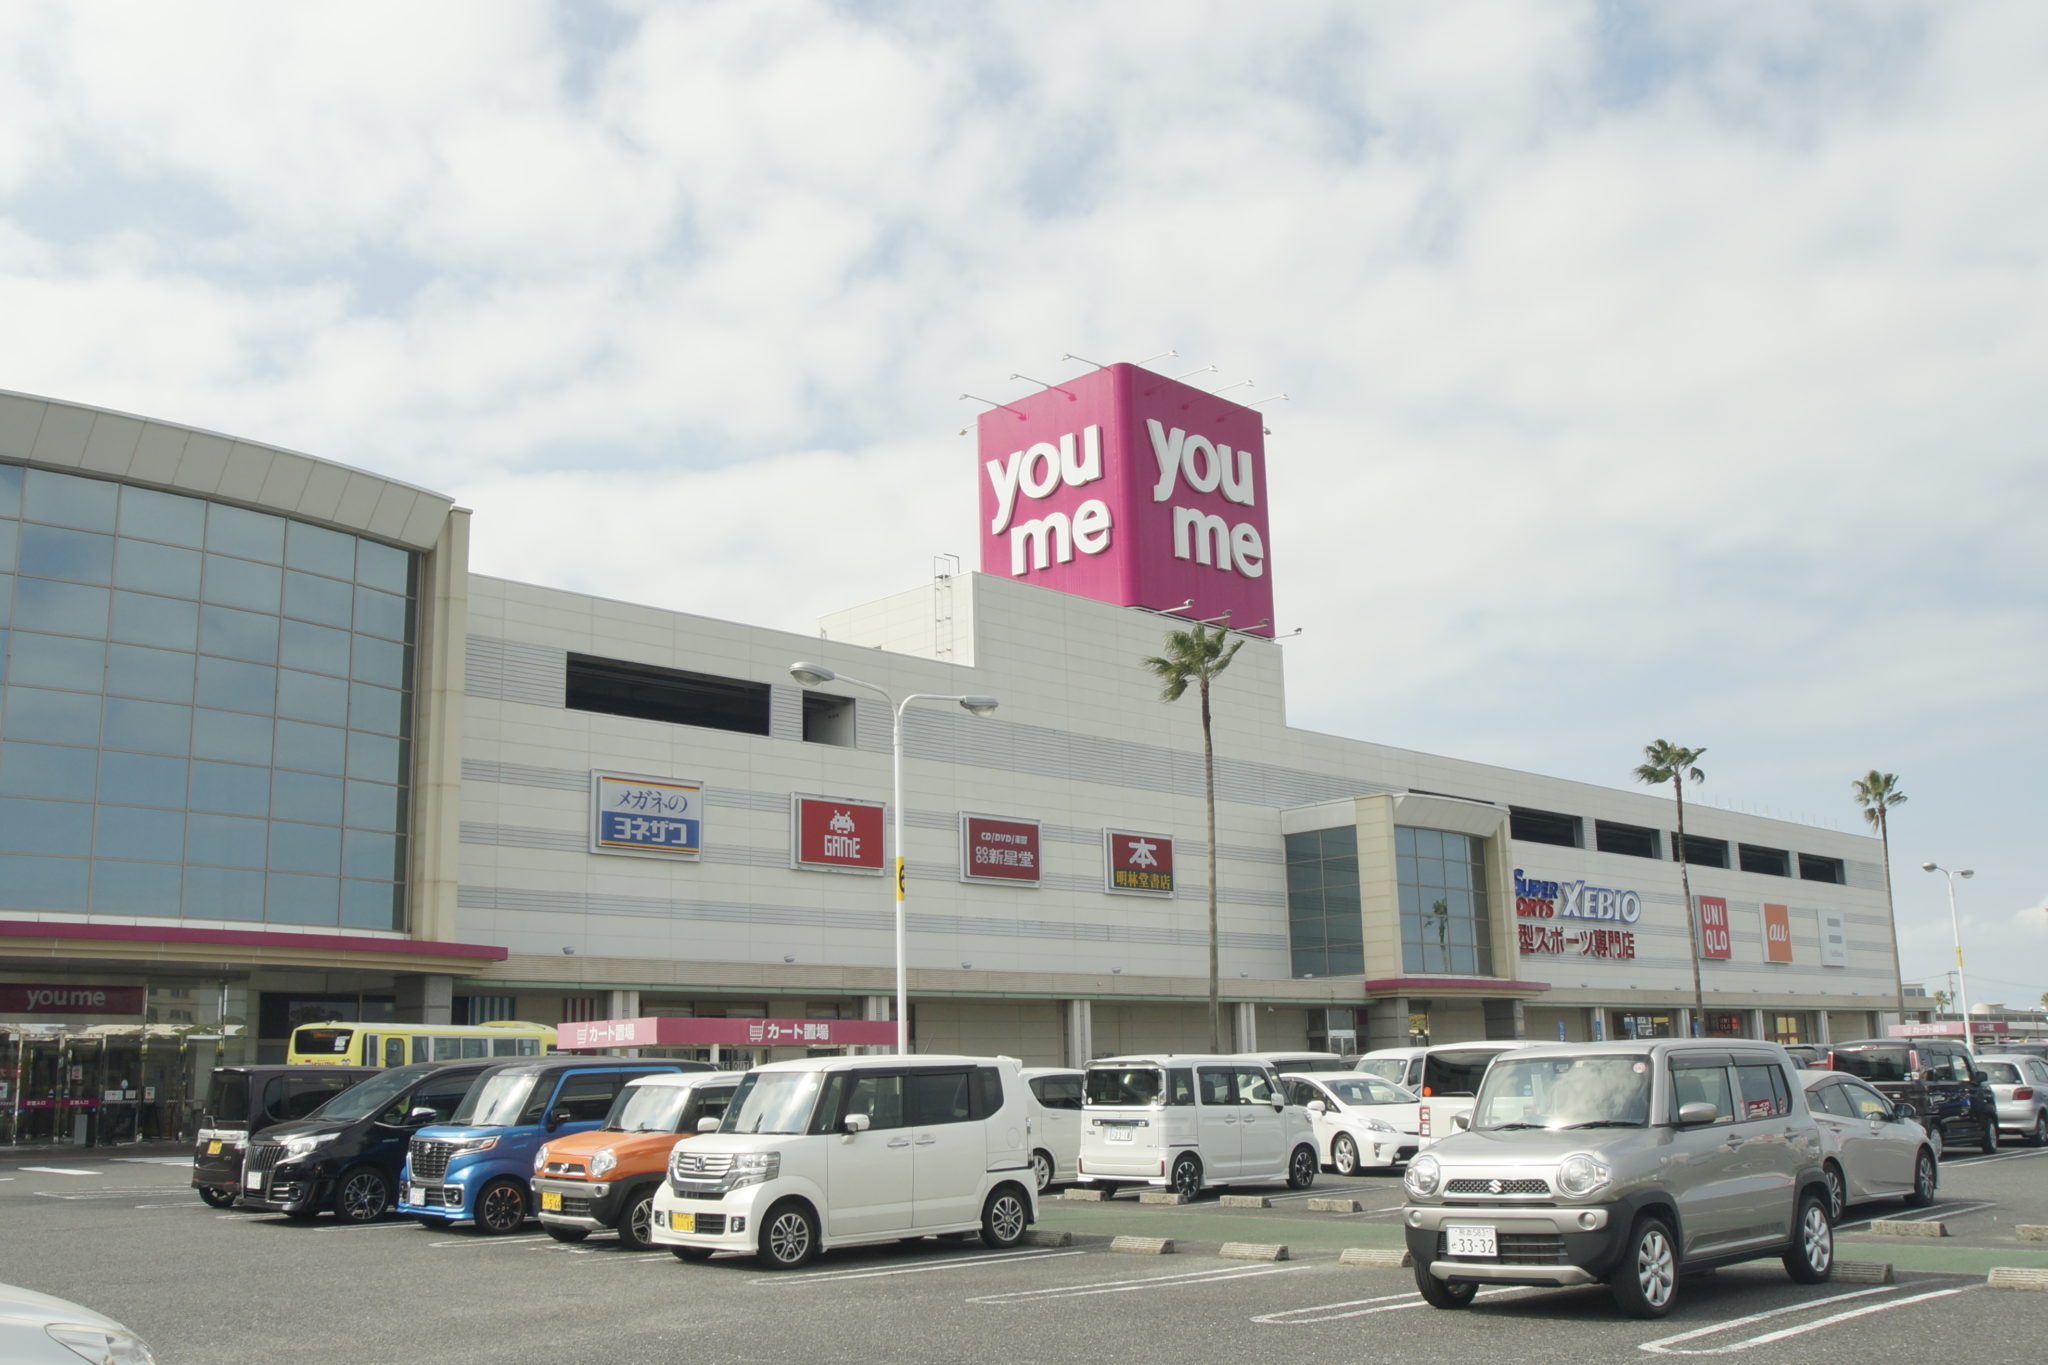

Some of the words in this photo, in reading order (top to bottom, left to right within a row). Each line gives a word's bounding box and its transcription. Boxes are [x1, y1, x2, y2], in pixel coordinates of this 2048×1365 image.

[1146, 418, 1255, 506] you
[986, 424, 1103, 535] you
[1010, 499, 1113, 577] me
[1172, 506, 1264, 578] me
[616, 789, 688, 814] メガネの
[613, 816, 687, 845] ヨネザワ
[824, 834, 861, 859] GAME
[989, 848, 1034, 867] 新星堂
[1128, 838, 1158, 869] 本
[1116, 871, 1171, 890] 明林堂書店
[1513, 868, 1559, 899] SUPER
[1561, 880, 1641, 924] XEBIO
[1703, 903, 1724, 926] UNI
[1518, 923, 1636, 959] 型スポーツ専門店
[1706, 930, 1727, 952] QLO
[1768, 923, 1789, 941] au
[588, 1024, 635, 1041] カート置場
[767, 1023, 830, 1041] カート置場
[1459, 1238, 1495, 1254] 33-32
